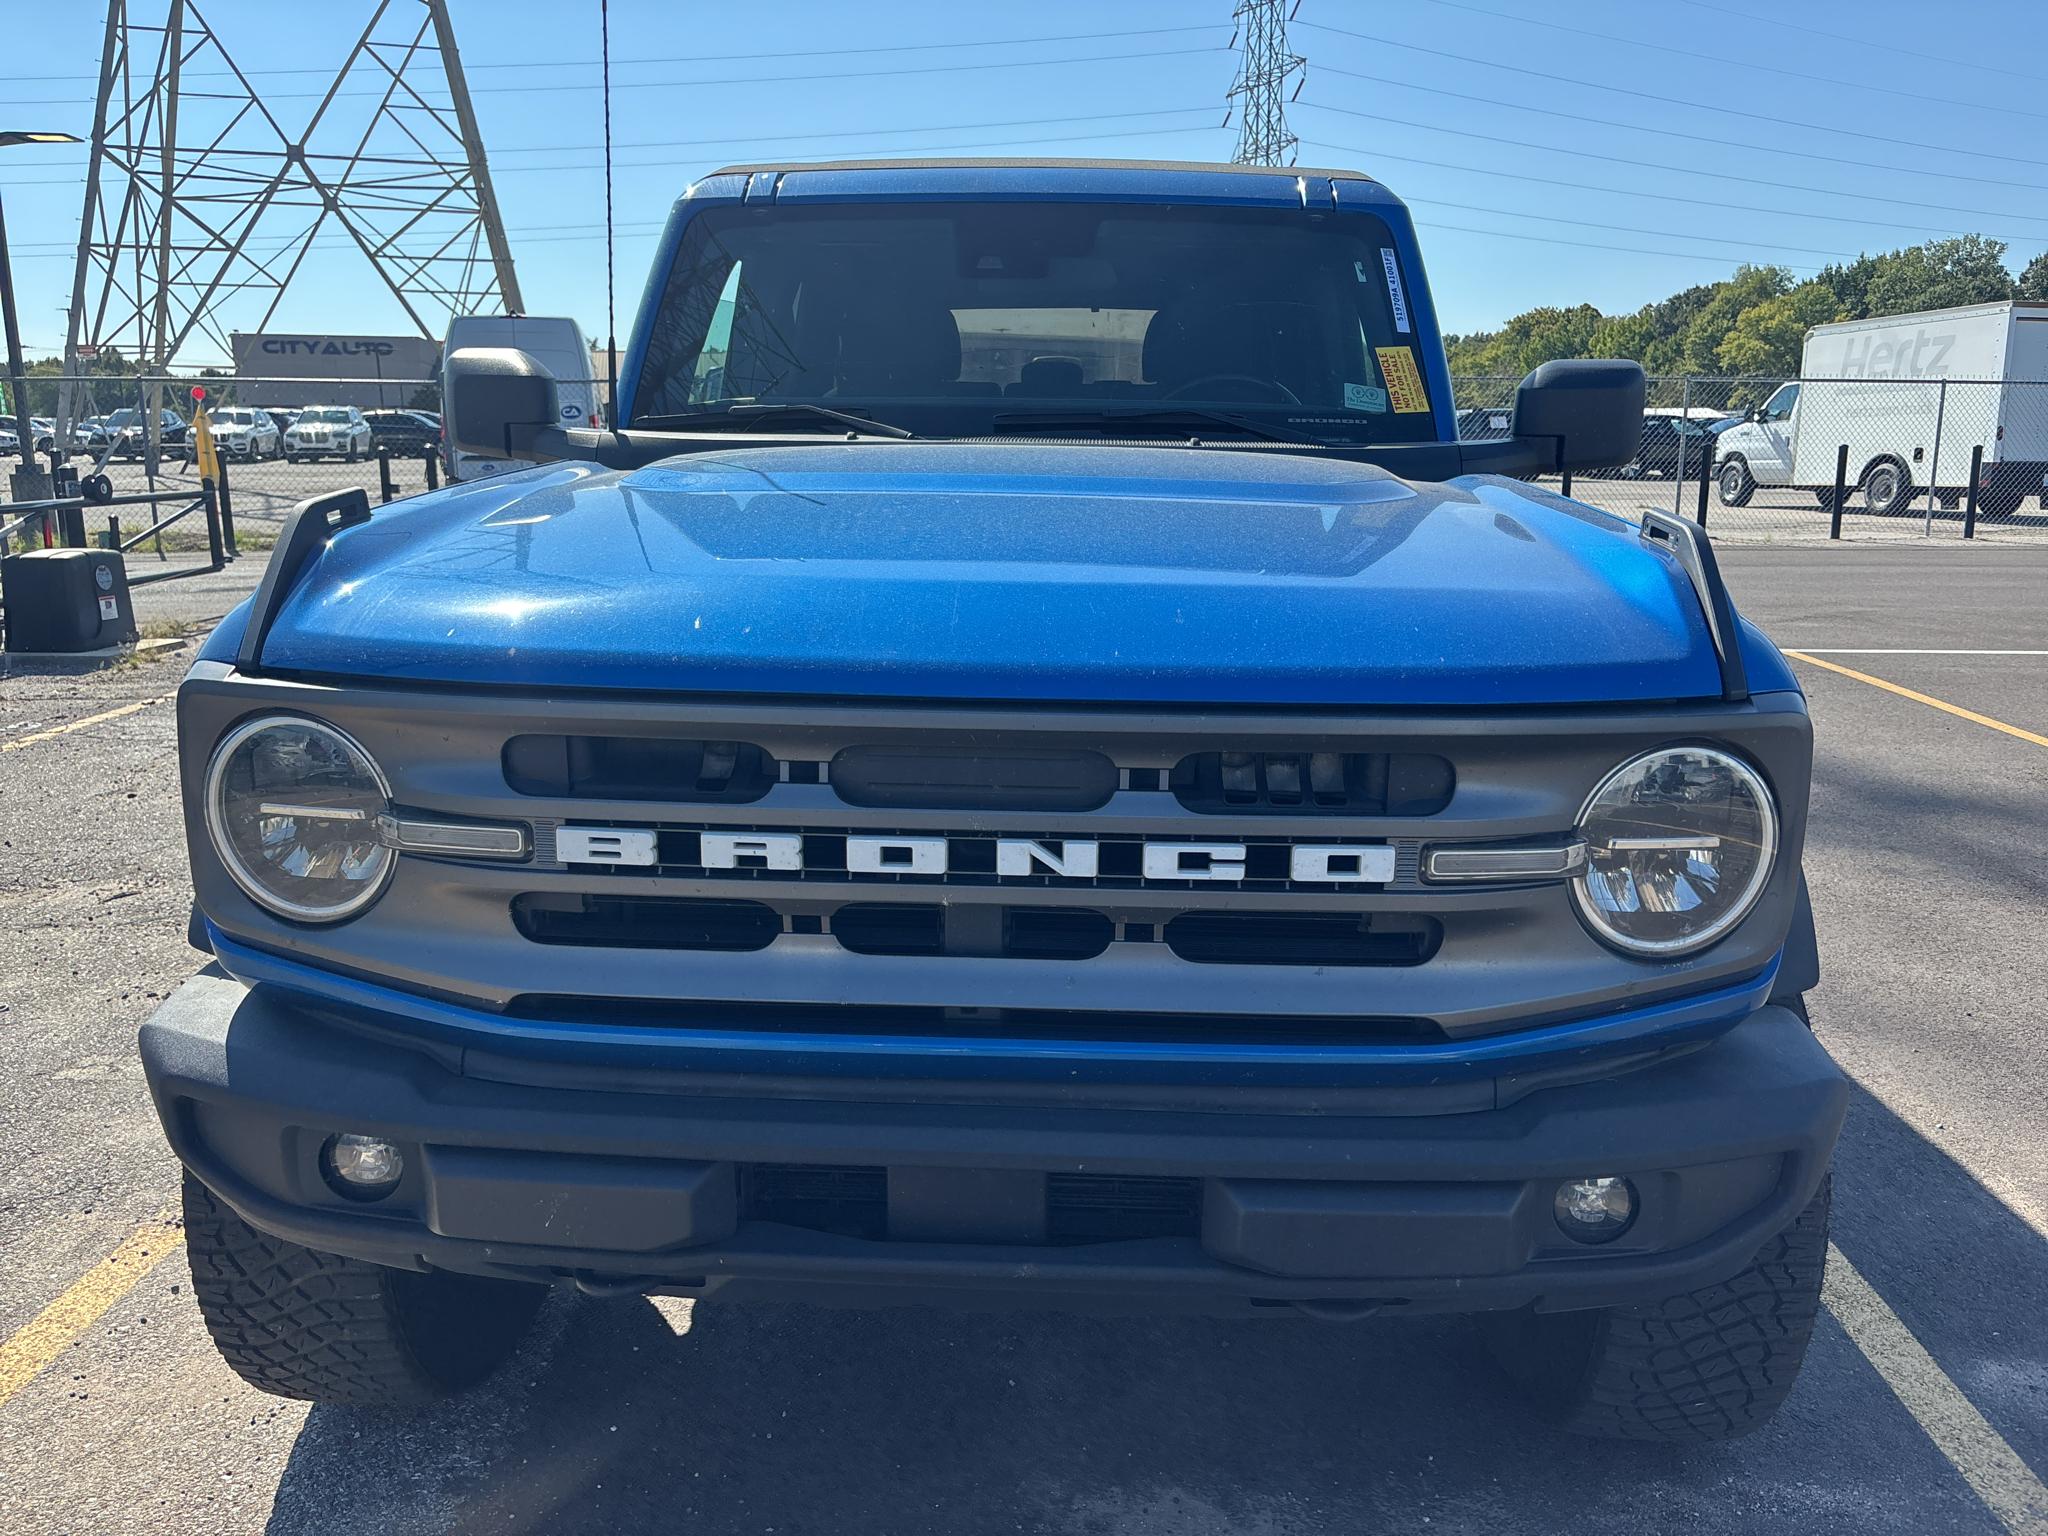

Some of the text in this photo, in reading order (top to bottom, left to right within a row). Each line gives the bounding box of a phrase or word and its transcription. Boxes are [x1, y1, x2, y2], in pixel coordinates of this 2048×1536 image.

[1388, 353, 1401, 373] SALE
[1840, 329, 1956, 376] Hertz
[1378, 352, 1404, 411] THIS VEHICLE
[1395, 375, 1406, 390] FOR
[1400, 392, 1411, 408] NOT
[555, 829, 1396, 882] BRONCO
